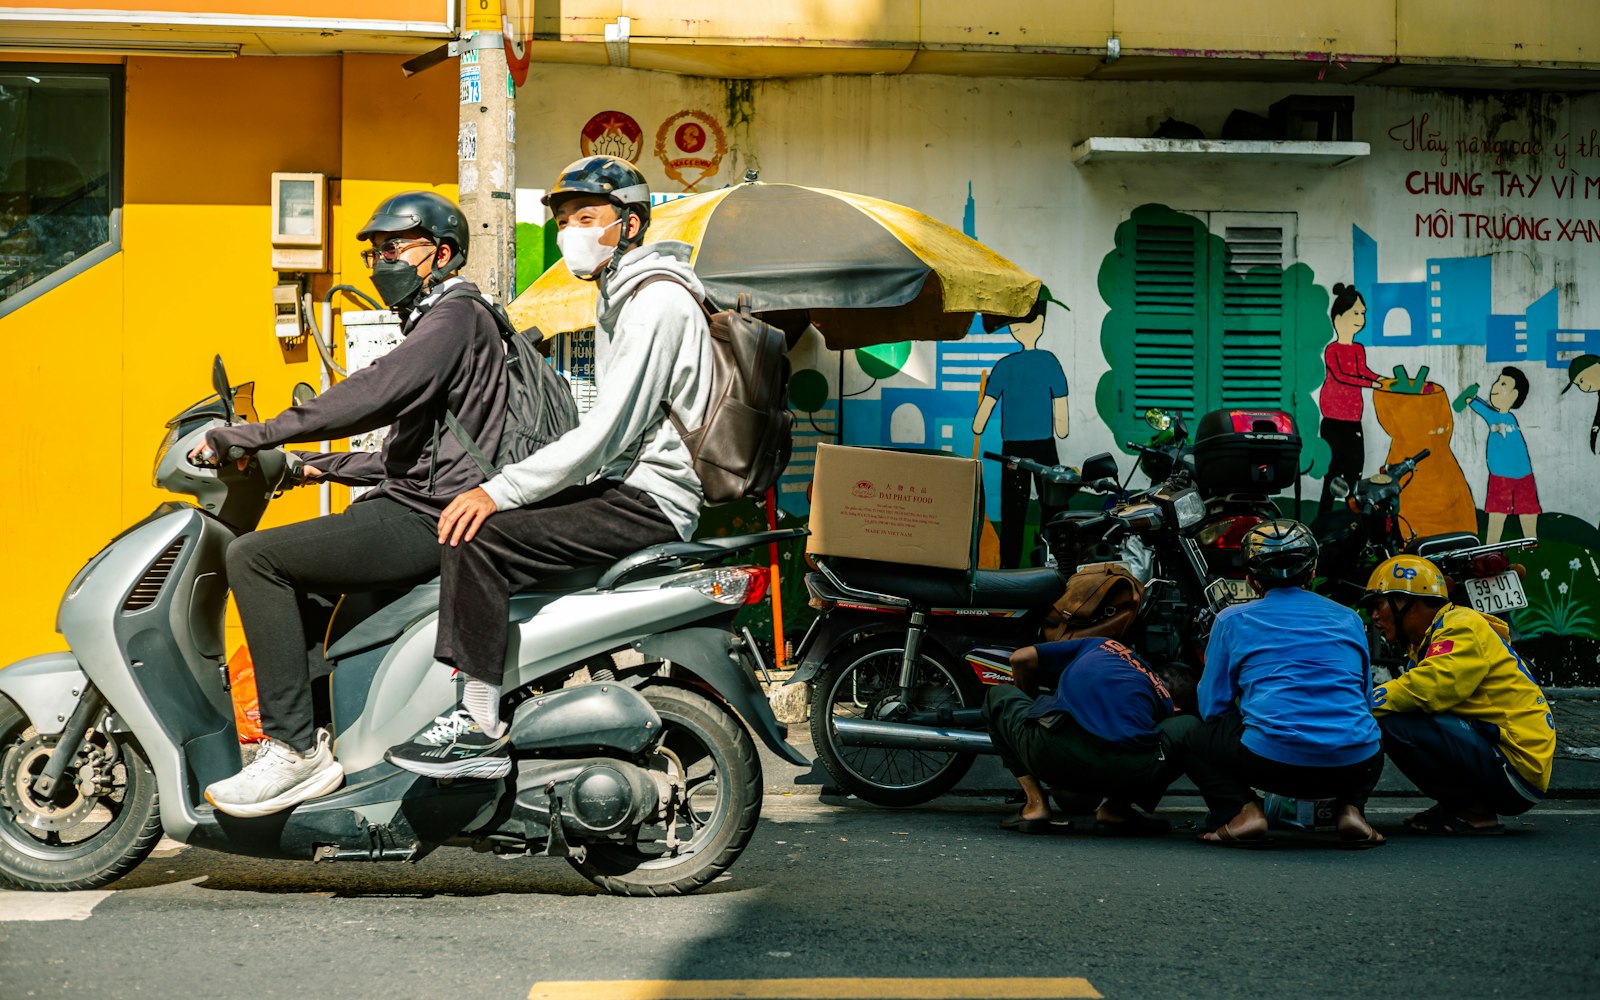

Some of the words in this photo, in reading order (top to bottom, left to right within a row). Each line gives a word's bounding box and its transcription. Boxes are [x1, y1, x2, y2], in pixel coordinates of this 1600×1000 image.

[1509, 140, 1544, 156] cao
[1554, 132, 1570, 170] ý
[1405, 170, 1485, 197] CHUNG
[1491, 170, 1543, 199] TAY
[1551, 168, 1579, 199] VÌ
[1584, 176, 1600, 200] M
[1415, 207, 1454, 239] MÔI
[1556, 218, 1600, 243] XAN
[913, 495, 933, 504] FOOD
[1392, 563, 1417, 580] be
[1474, 574, 1513, 597] 59-U1
[1475, 590, 1524, 613] 970.43
[982, 671, 1014, 682] Drea
